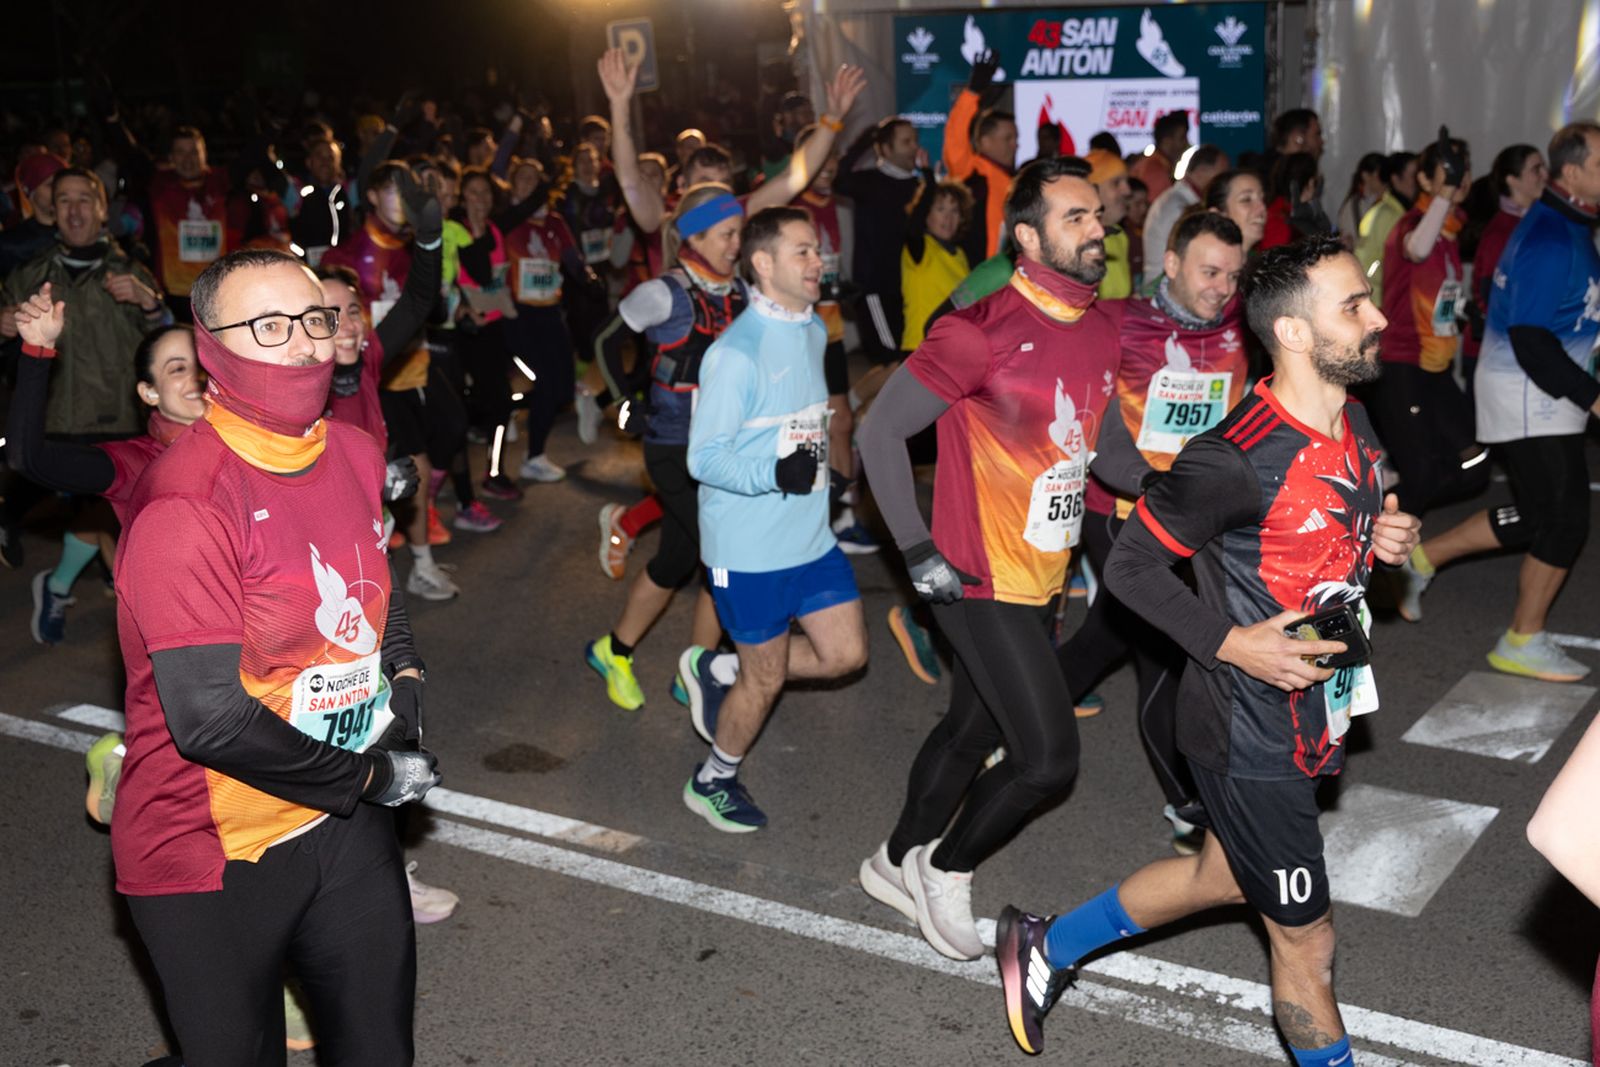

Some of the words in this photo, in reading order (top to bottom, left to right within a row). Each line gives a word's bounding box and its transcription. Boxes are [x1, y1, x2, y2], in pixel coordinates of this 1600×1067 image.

[1061, 16, 1119, 47] SAN
[1163, 402, 1212, 426] 7957
[1063, 428, 1081, 454] 43
[334, 610, 363, 643] 43
[326, 674, 359, 693] NOCHE
[358, 670, 370, 684] DE
[308, 696, 336, 712] SAN
[322, 697, 377, 746] 7941
[1272, 866, 1312, 905] 10
